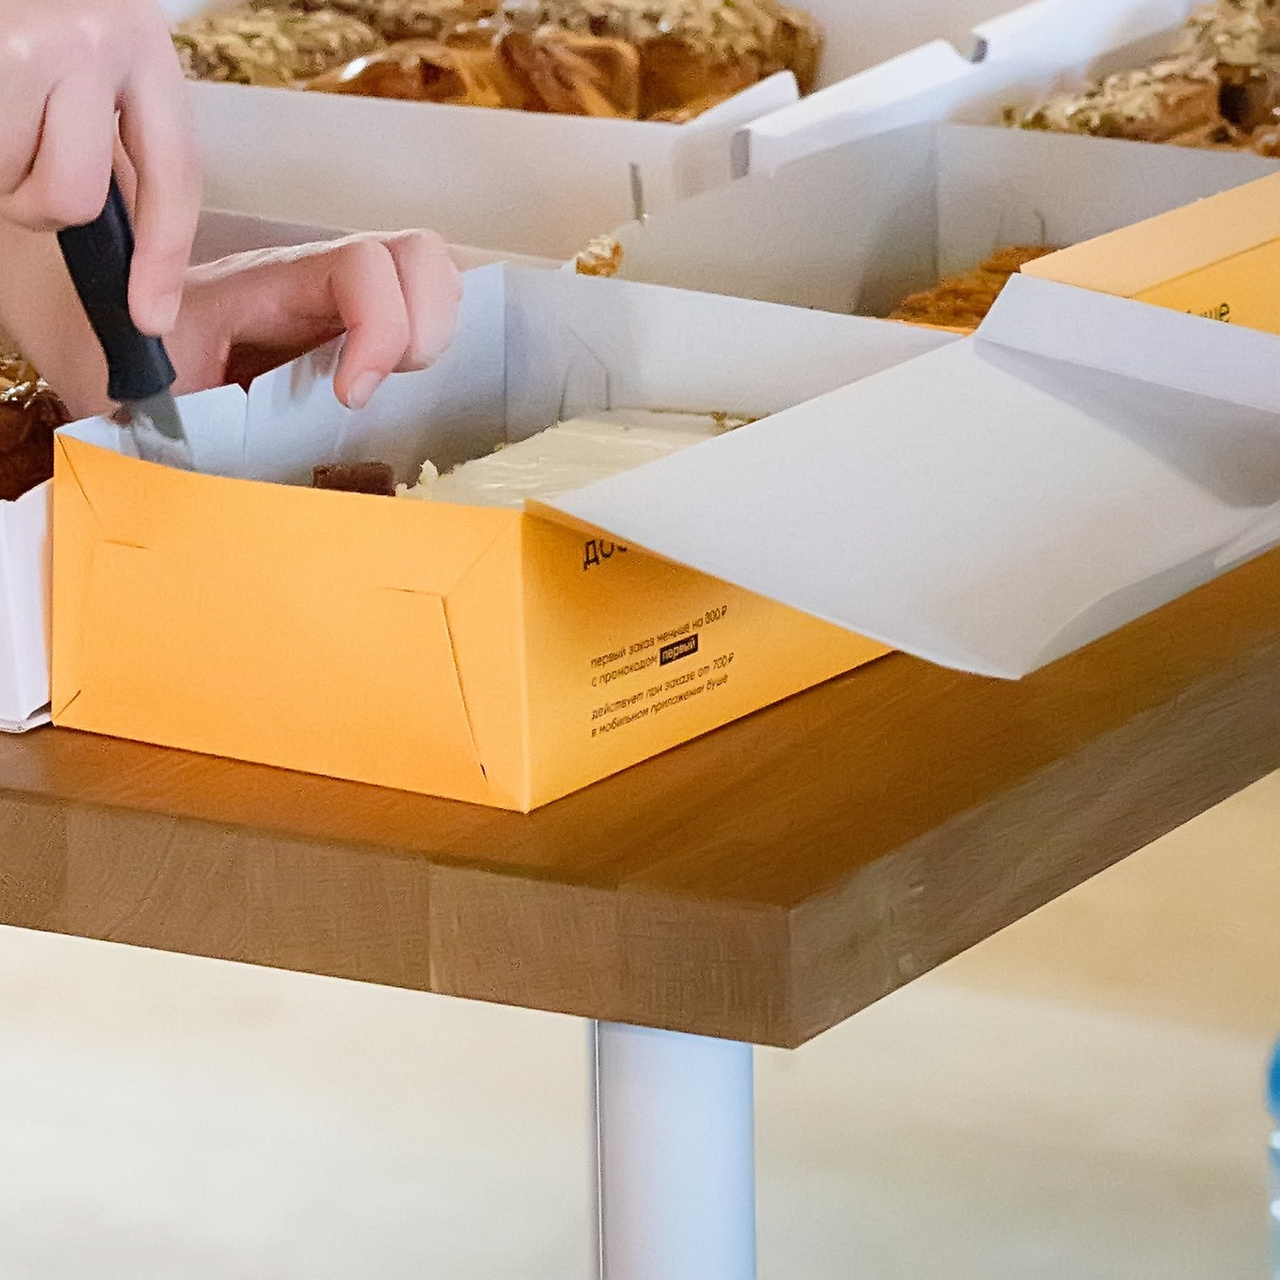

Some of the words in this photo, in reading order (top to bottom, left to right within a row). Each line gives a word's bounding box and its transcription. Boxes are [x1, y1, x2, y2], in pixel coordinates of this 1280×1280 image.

[583, 538, 628, 571] до
[591, 647, 626, 668] первый
[628, 638, 655, 655] заказ
[599, 654, 658, 684] промокодом
[591, 692, 644, 721] действует
[665, 671, 695, 691] заказе
[599, 707, 649, 733] мобильном
[705, 674, 728, 691] буше
